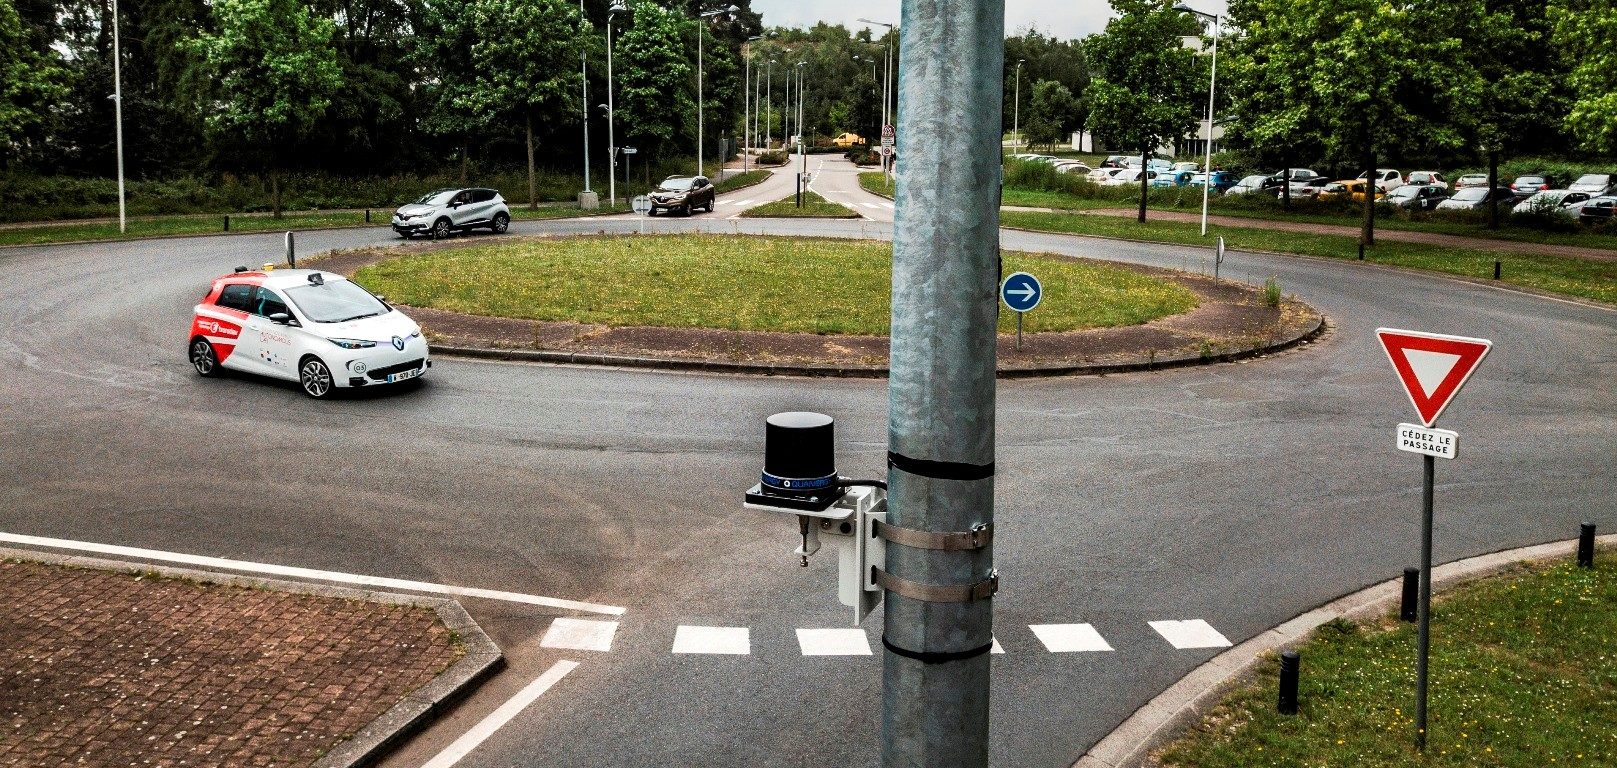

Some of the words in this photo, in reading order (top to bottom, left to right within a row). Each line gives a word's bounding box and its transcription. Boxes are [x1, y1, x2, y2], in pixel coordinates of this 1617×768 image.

[1402, 430, 1434, 442] CÉDEZ
[1439, 437, 1451, 445] LE
[1403, 440, 1448, 454] PASSAGE
